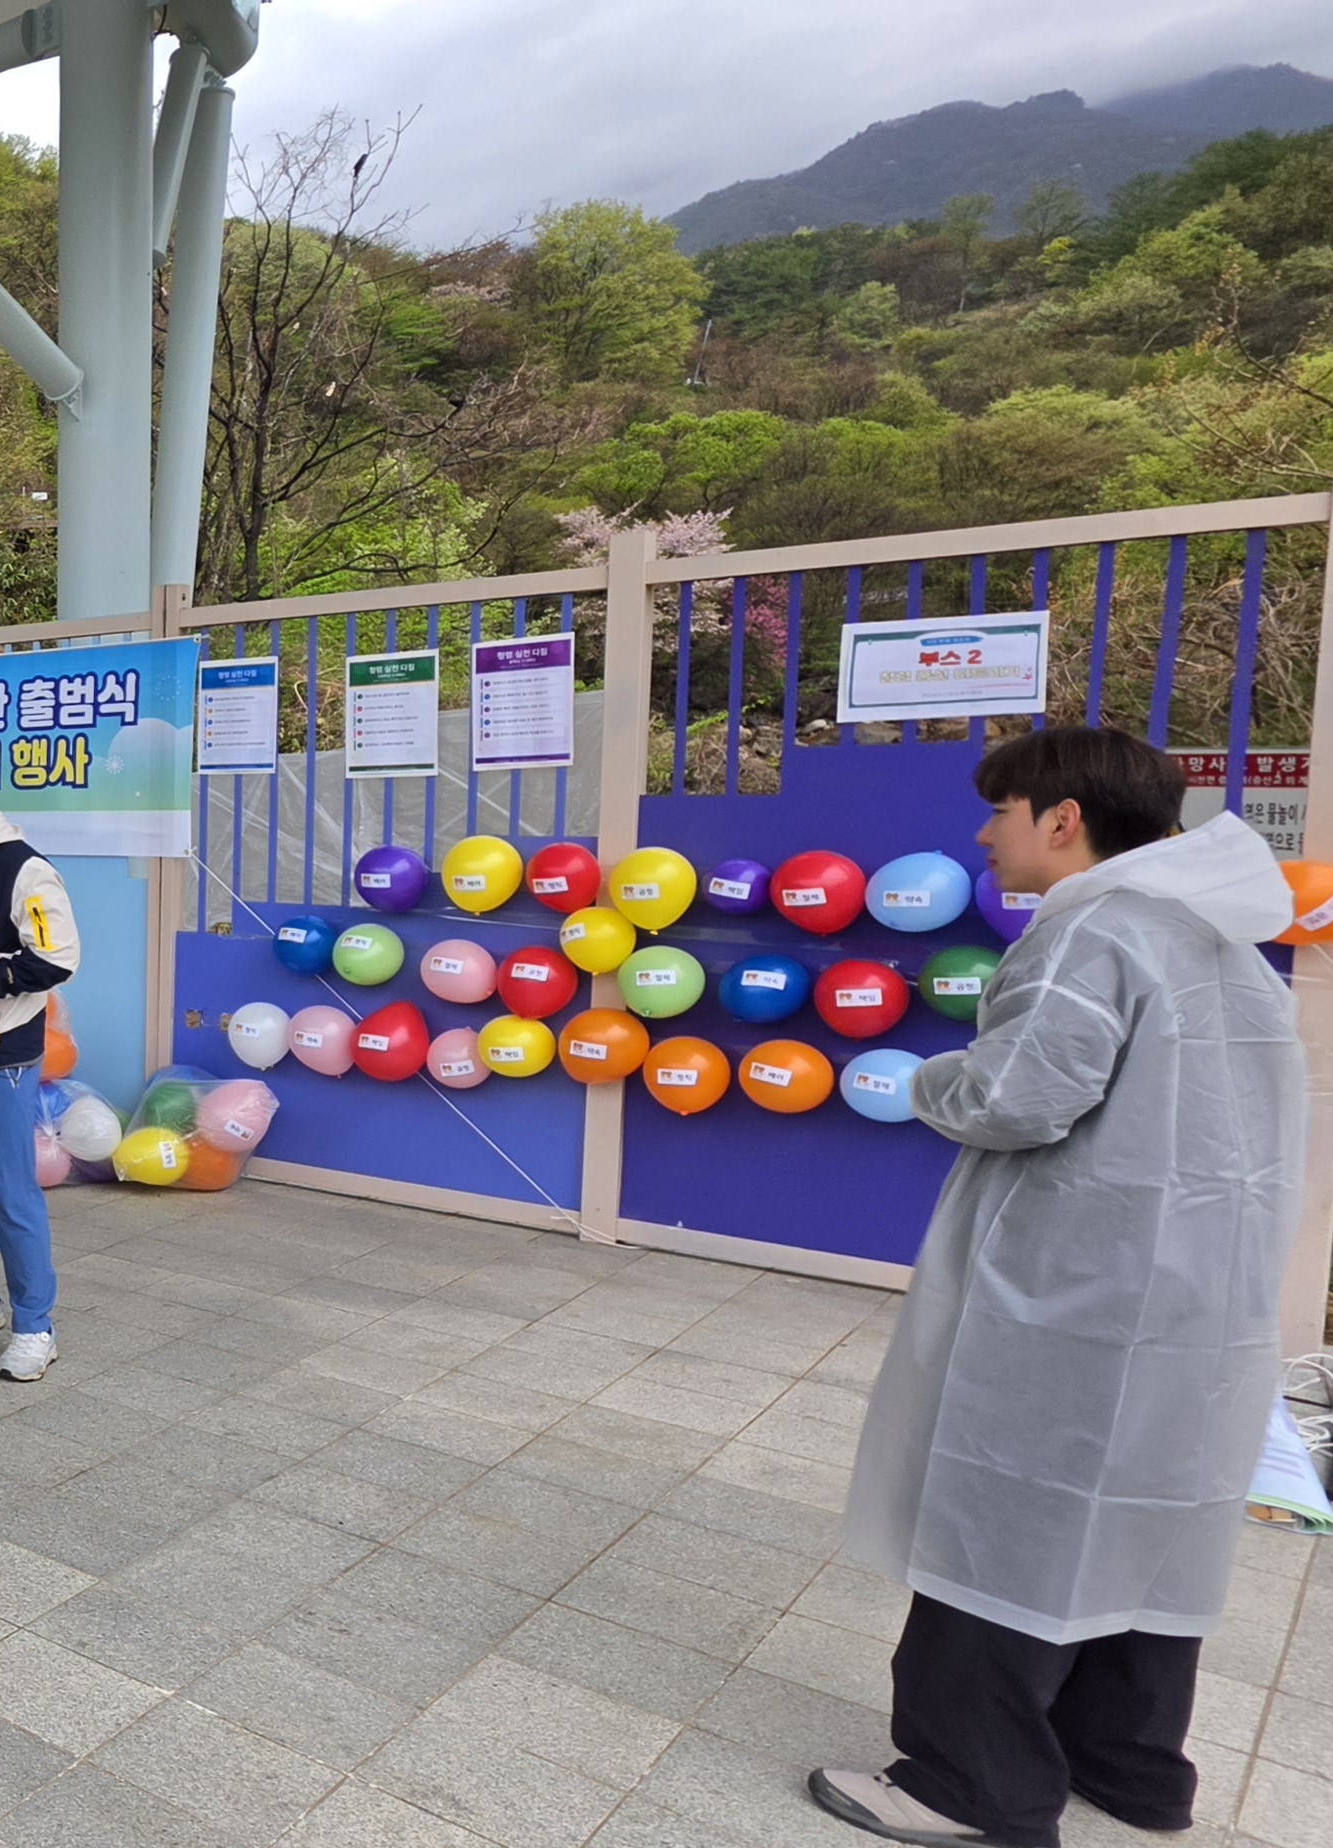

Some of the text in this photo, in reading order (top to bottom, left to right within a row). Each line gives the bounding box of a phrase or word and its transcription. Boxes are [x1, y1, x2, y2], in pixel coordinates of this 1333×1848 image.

[918, 650, 982, 667] 부스 2
[18, 670, 139, 731] 출범식
[10, 734, 90, 789] 행사
